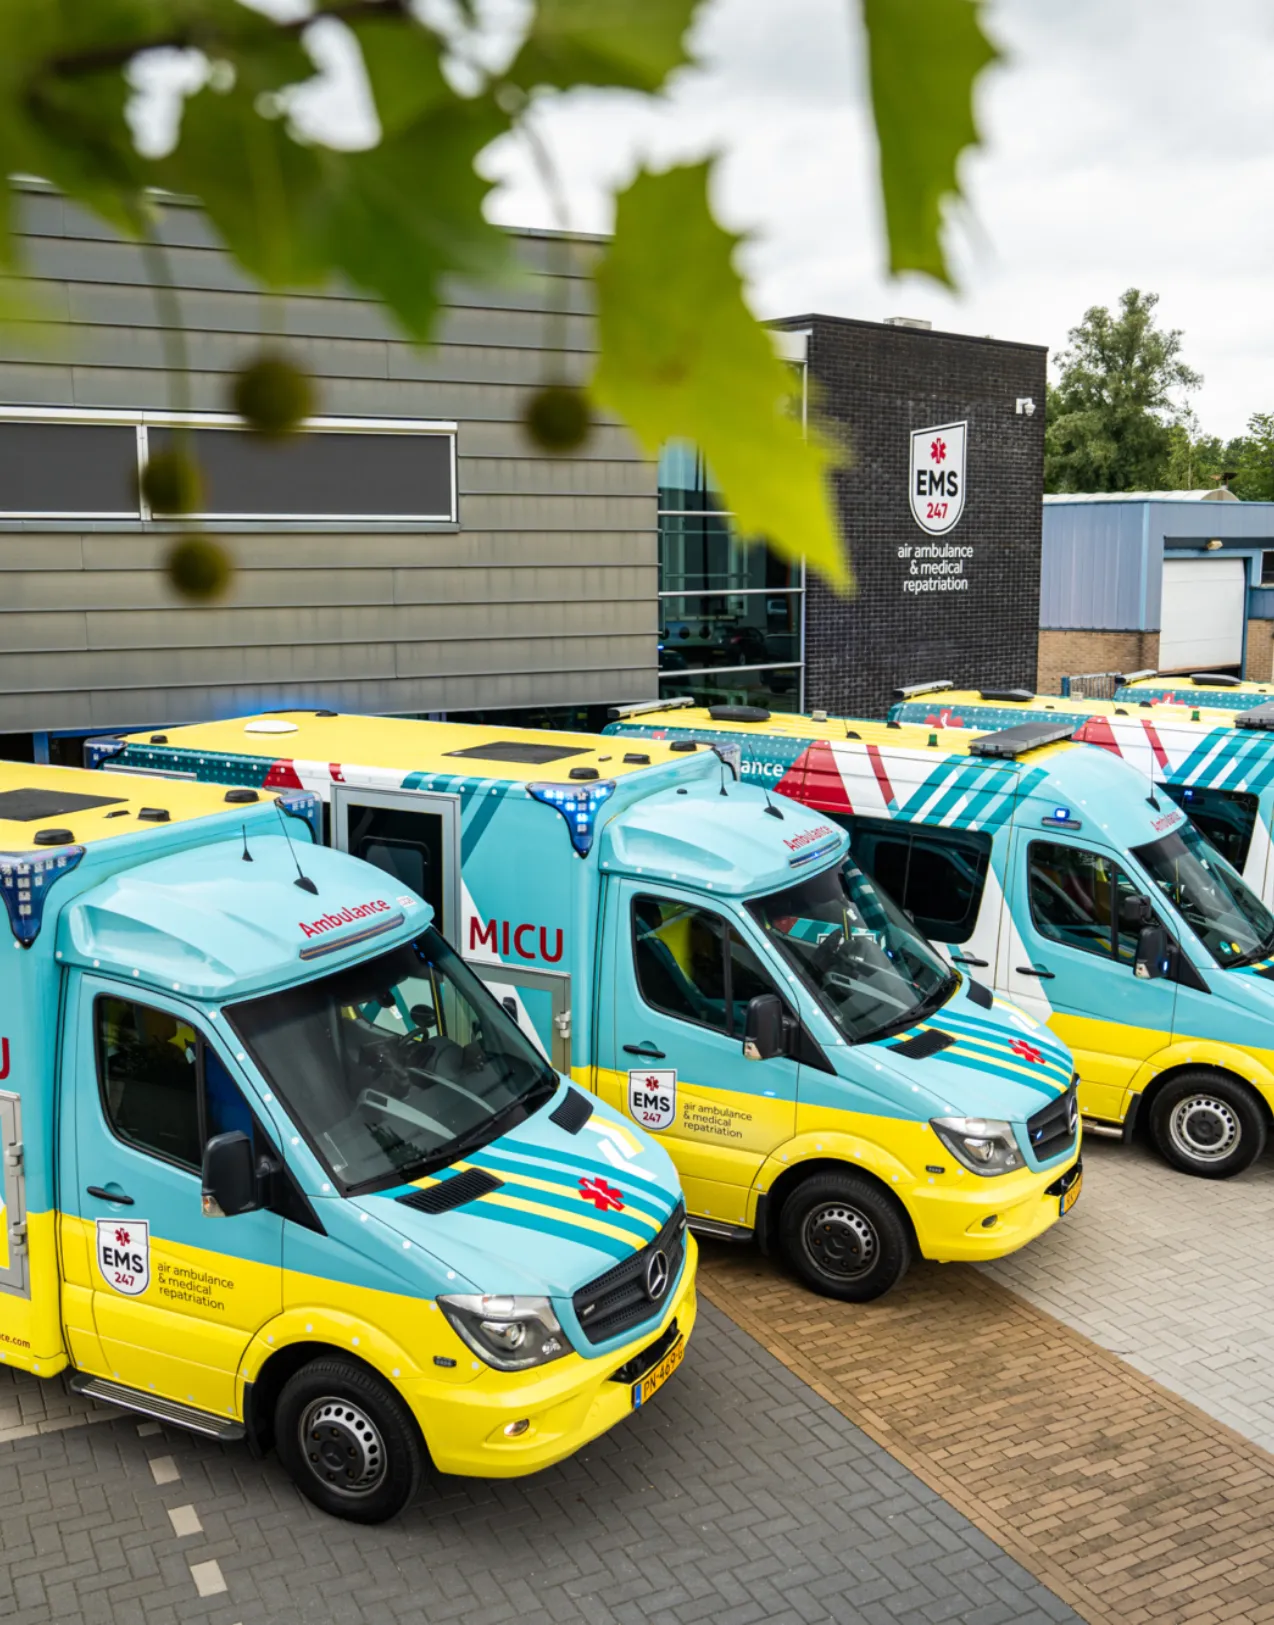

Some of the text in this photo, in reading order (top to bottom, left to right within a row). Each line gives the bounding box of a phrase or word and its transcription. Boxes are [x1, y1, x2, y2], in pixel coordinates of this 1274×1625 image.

[916, 469, 959, 497] EMS
[926, 502, 948, 519] 247
[897, 543, 974, 558] air ambulance
[909, 559, 963, 575] & medical
[903, 576, 968, 595] repatriation
[298, 899, 391, 939] Ambulance
[469, 915, 563, 963] MICU
[633, 1091, 671, 1112] EMS
[642, 1111, 662, 1123] 247
[682, 1110, 732, 1127] & medical
[683, 1102, 753, 1121] air ambulance
[683, 1121, 743, 1138] repatriation
[102, 1246, 144, 1274] EMS
[114, 1271, 135, 1287] 247
[157, 1262, 235, 1290] air ambulance
[158, 1273, 212, 1296] & medical
[159, 1286, 225, 1311] repatriation
[0, 1333, 31, 1349] ce.com
